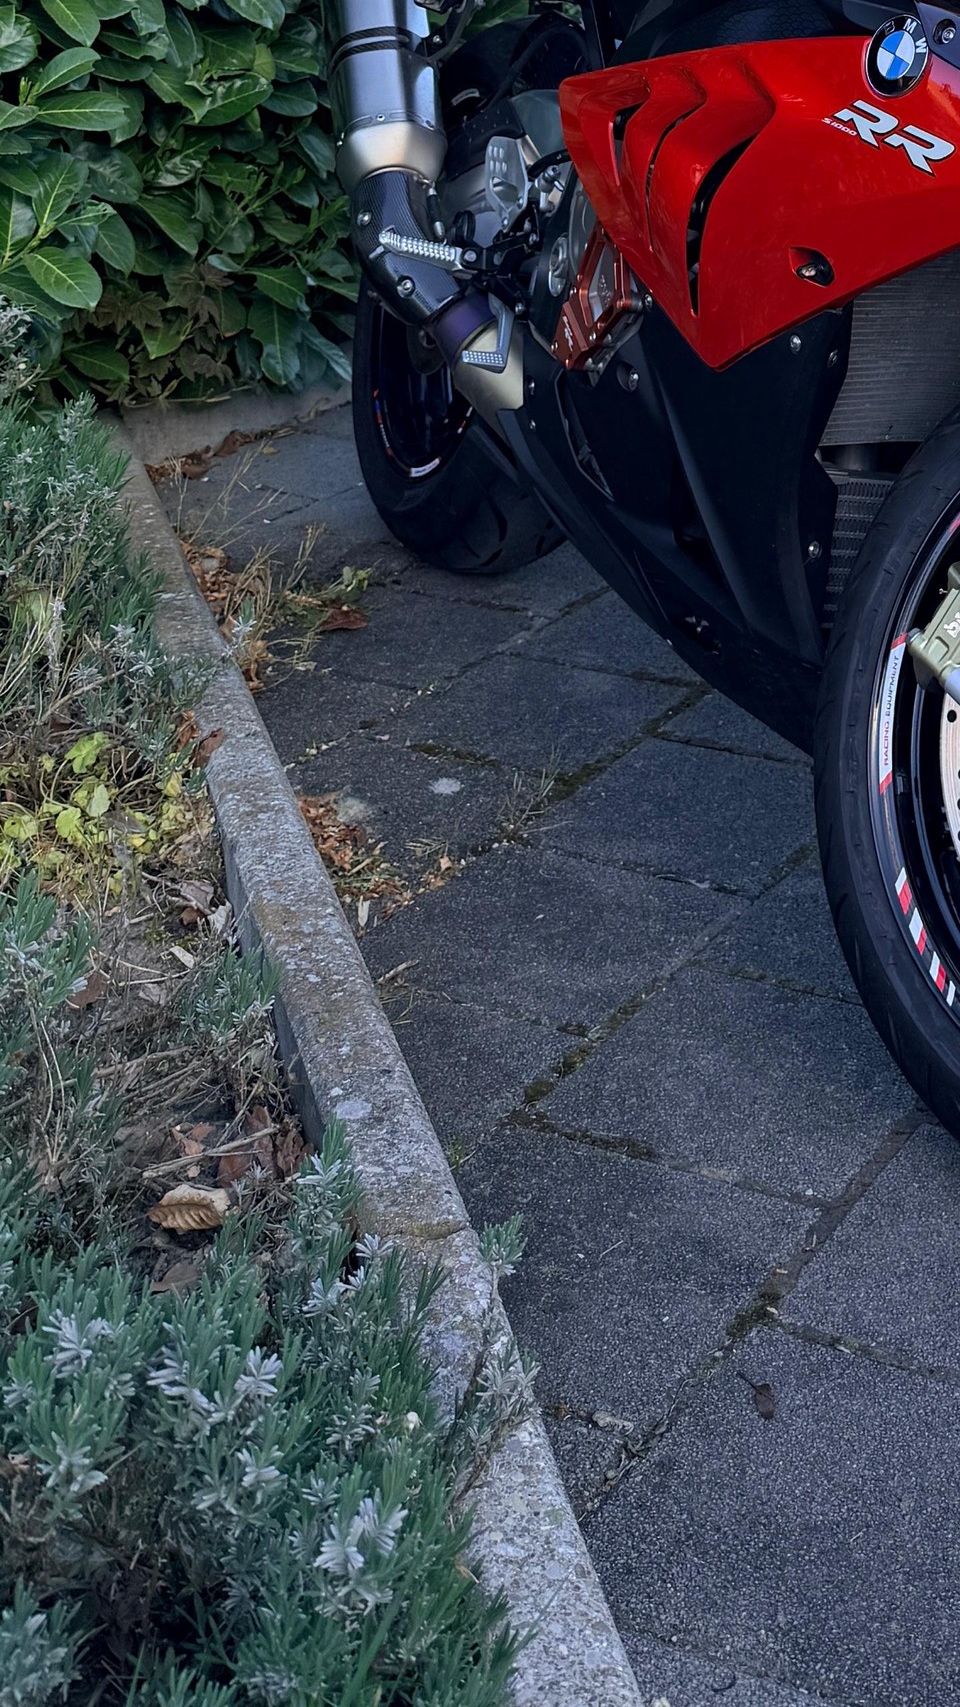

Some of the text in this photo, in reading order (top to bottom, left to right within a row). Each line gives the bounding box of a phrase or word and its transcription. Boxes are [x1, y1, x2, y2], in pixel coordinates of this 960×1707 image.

[883, 17, 928, 55] BMW
[821, 99, 956, 177] S1000 RR
[885, 655, 900, 717] EQUIPMENT
